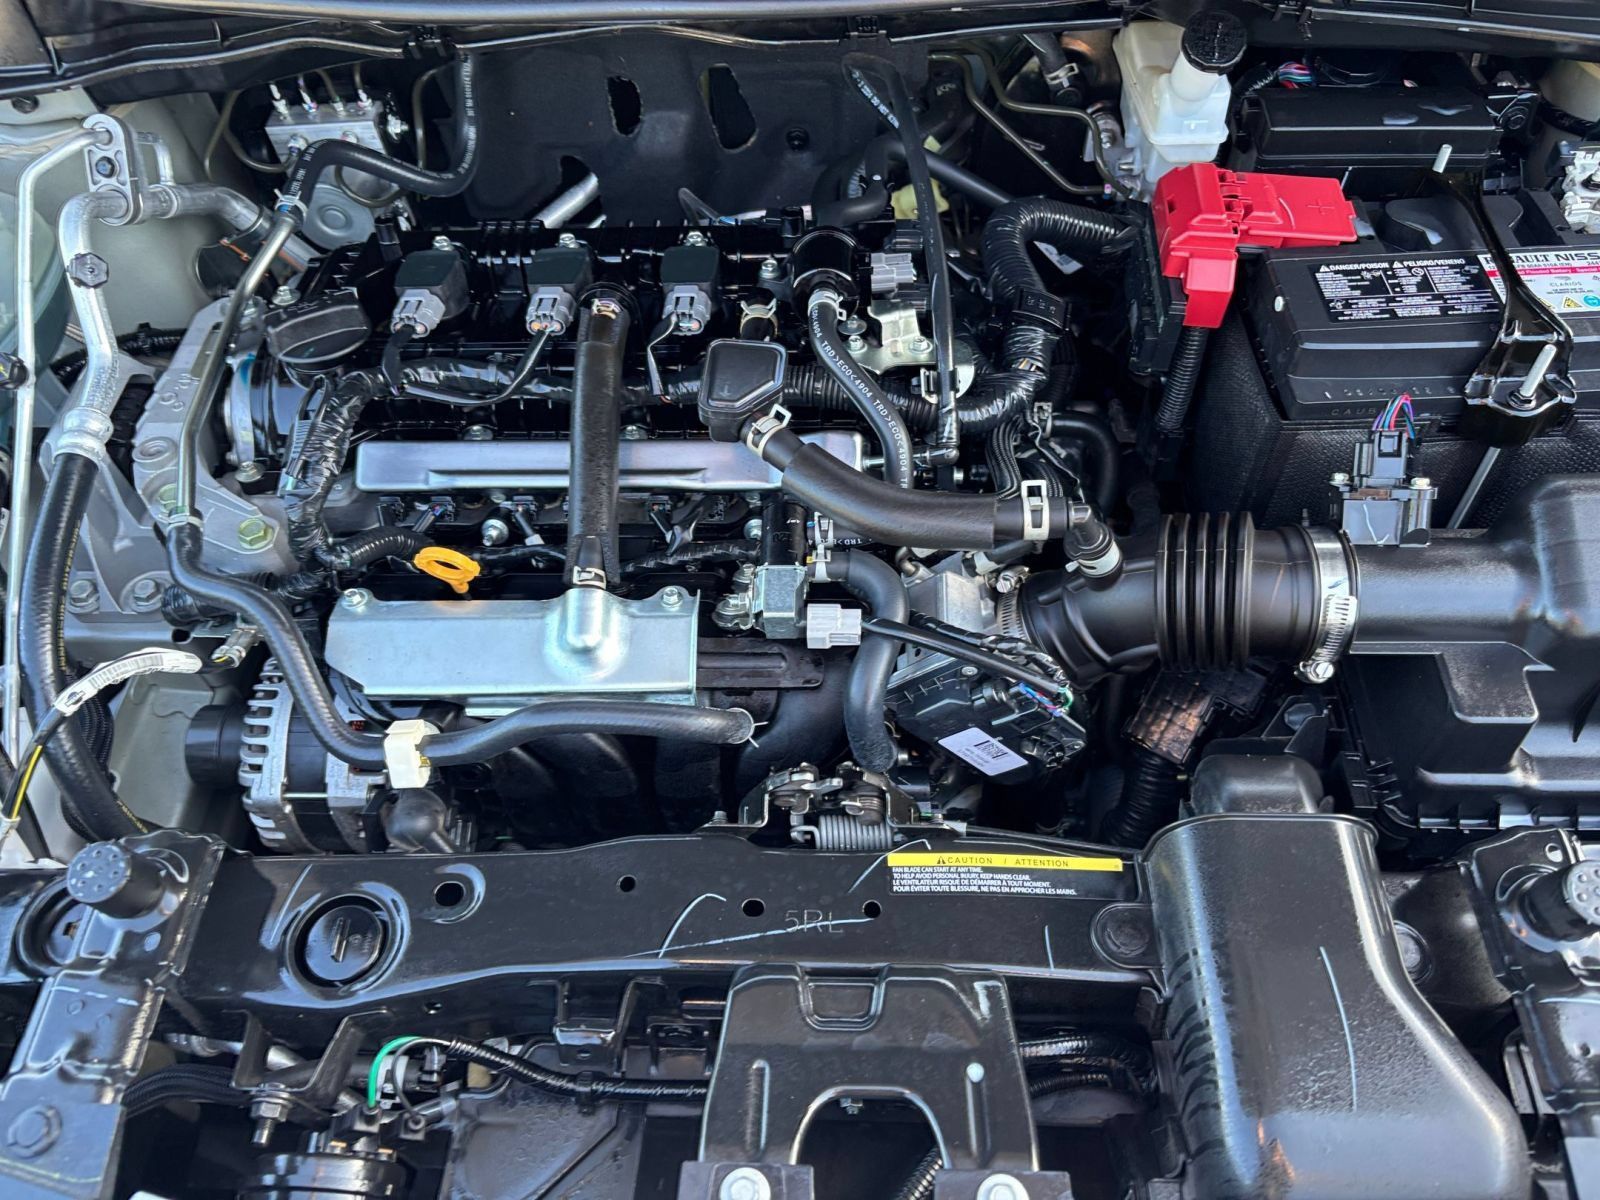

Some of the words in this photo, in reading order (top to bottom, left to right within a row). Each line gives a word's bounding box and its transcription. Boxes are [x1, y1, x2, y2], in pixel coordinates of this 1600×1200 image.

[1403, 258, 1466, 267] PELIGRO/VENENO
[1483, 254, 1550, 265] RAULT
[1329, 262, 1390, 271] DANGER/POISON
[948, 857, 993, 865] CAUTION
[1015, 858, 1069, 867] ATTENTION
